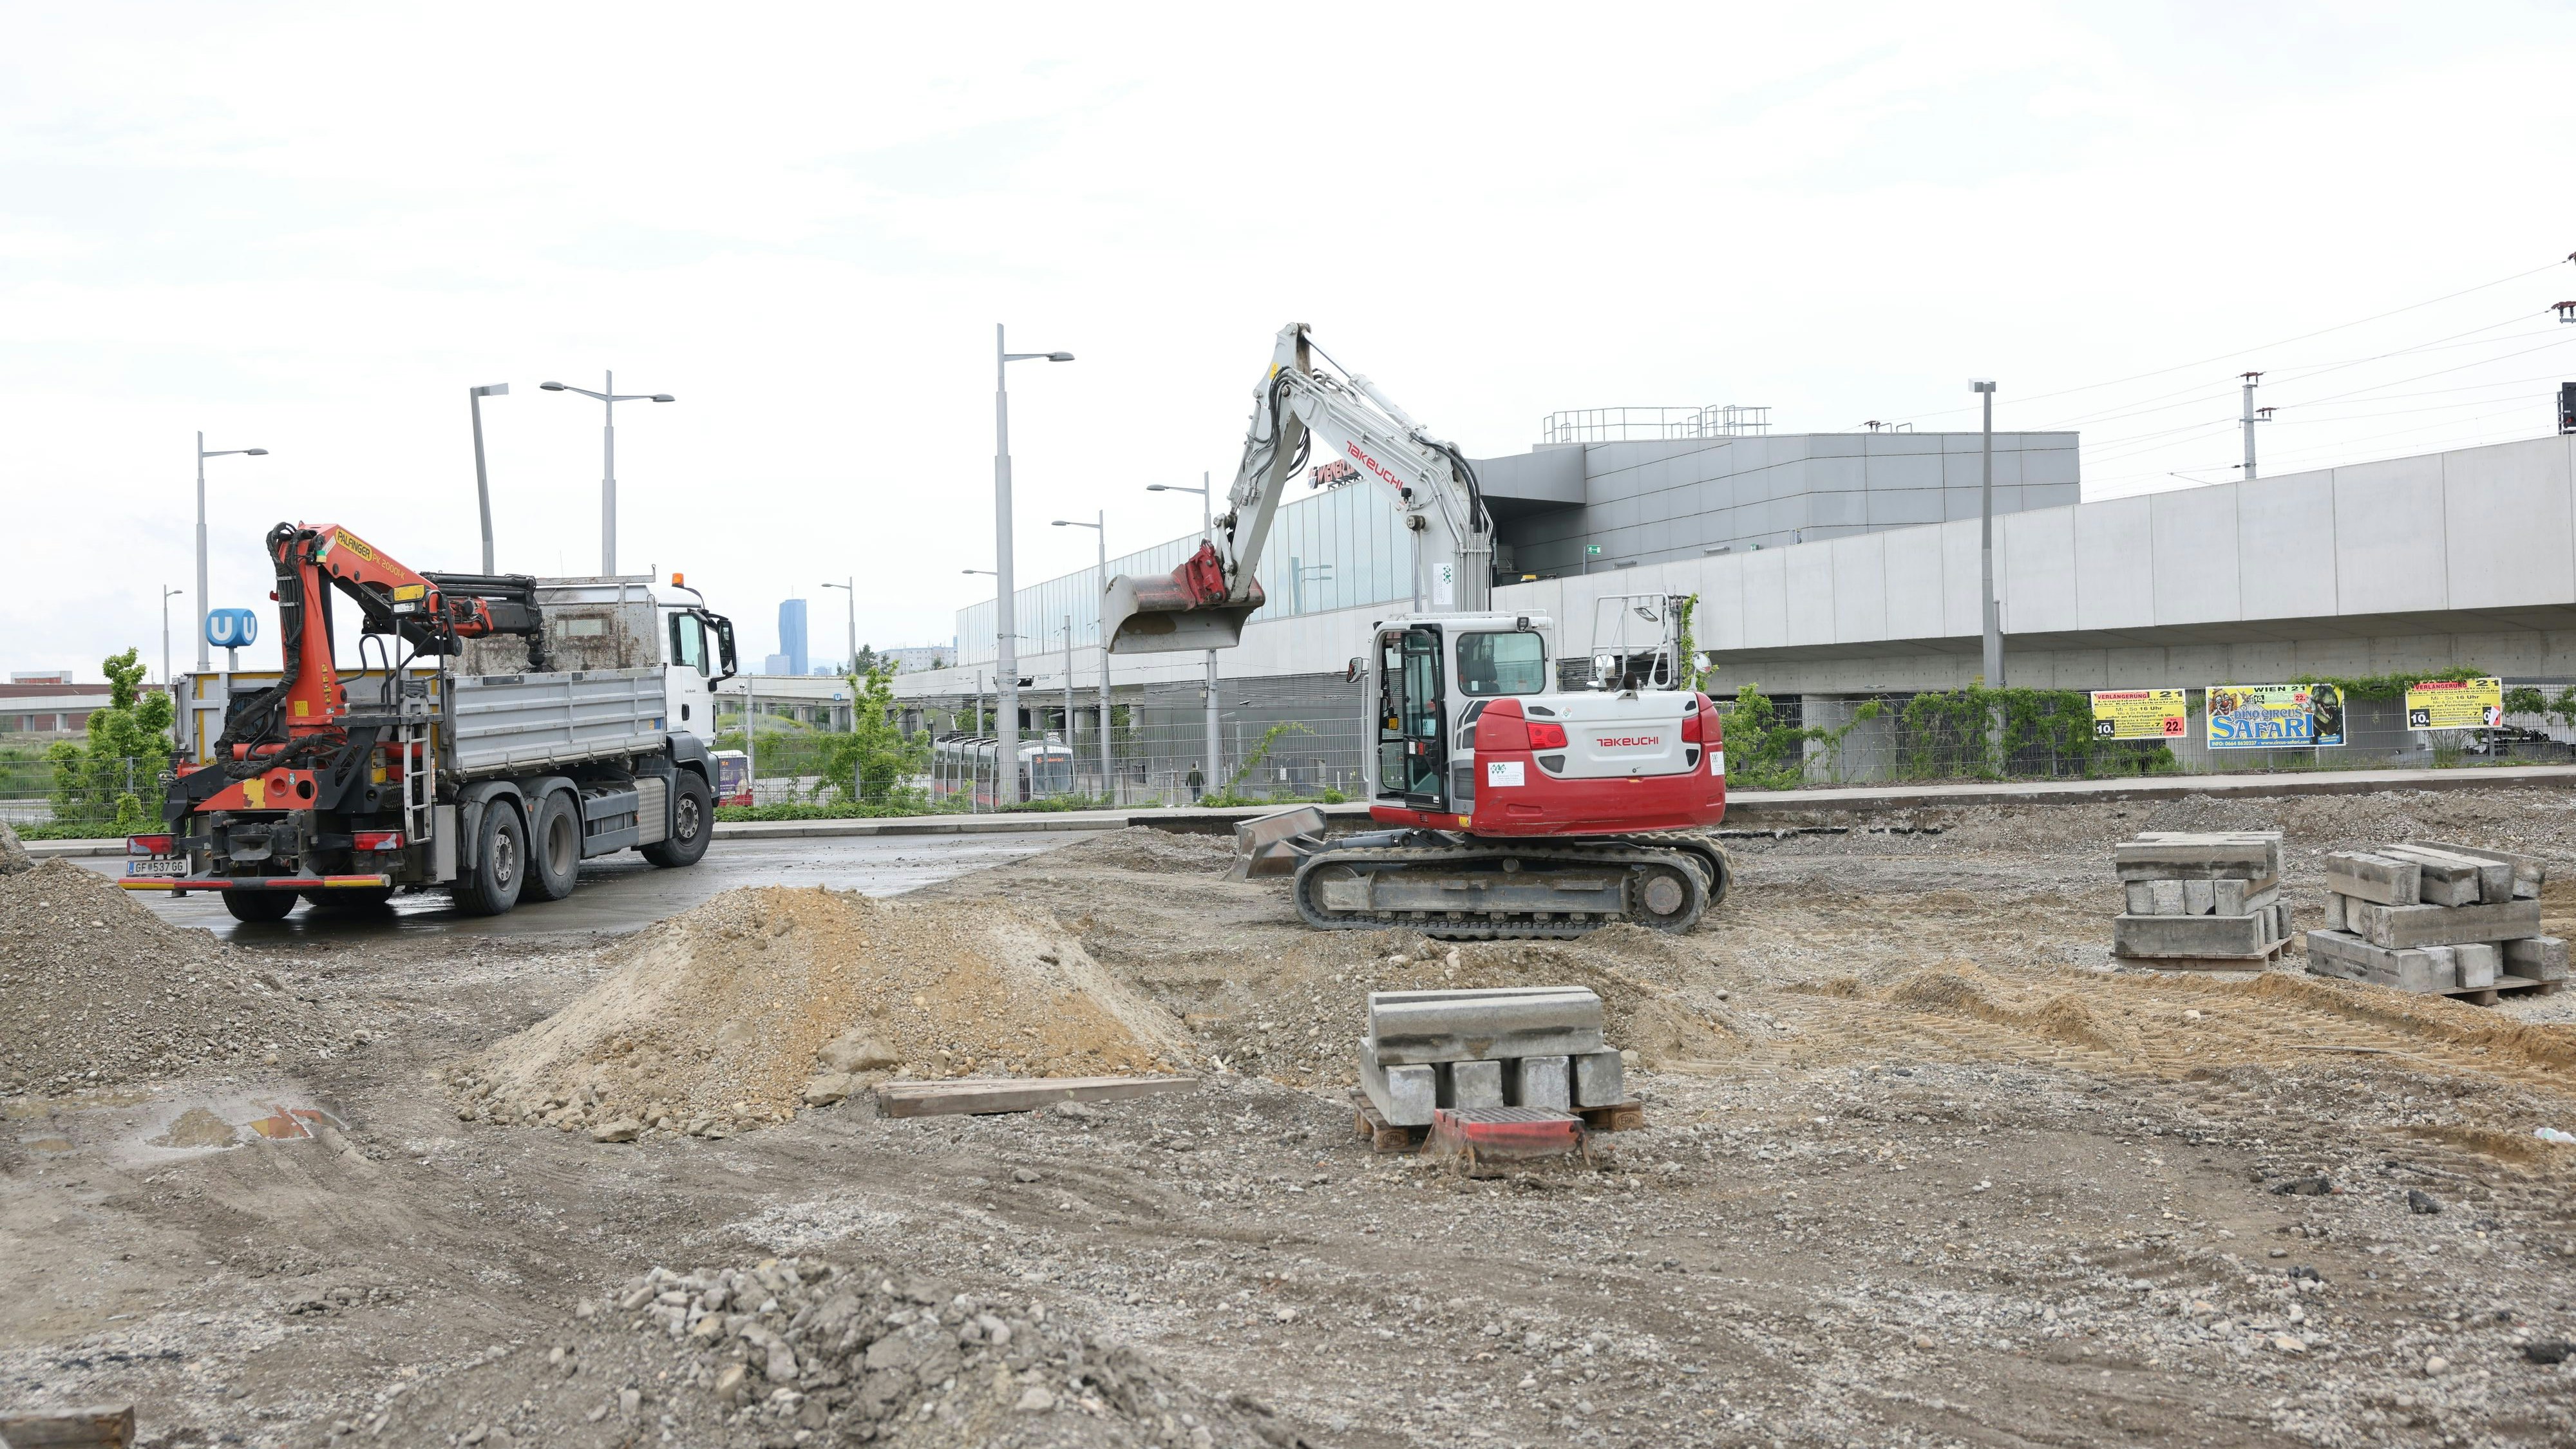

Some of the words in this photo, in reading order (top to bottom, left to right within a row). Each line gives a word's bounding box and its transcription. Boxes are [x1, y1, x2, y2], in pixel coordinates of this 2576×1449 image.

[1318, 459, 1346, 483] WIENER
[1347, 440, 1404, 491] TAKEUCHI
[337, 531, 370, 558] PALFINGER
[372, 553, 380, 564] PK
[211, 617, 232, 641] U
[243, 617, 255, 641] U
[2234, 710, 2259, 719] DINO
[2261, 709, 2302, 718] CIRCUS
[2410, 714, 2430, 723] 10.
[2096, 725, 2114, 734] 10.
[2166, 721, 2182, 732] 22.
[2211, 714, 2314, 739] SAFARI
[1596, 737, 1659, 747] TAKEUCHI
[136, 863, 146, 872] GF
[153, 862, 170, 871] 537
